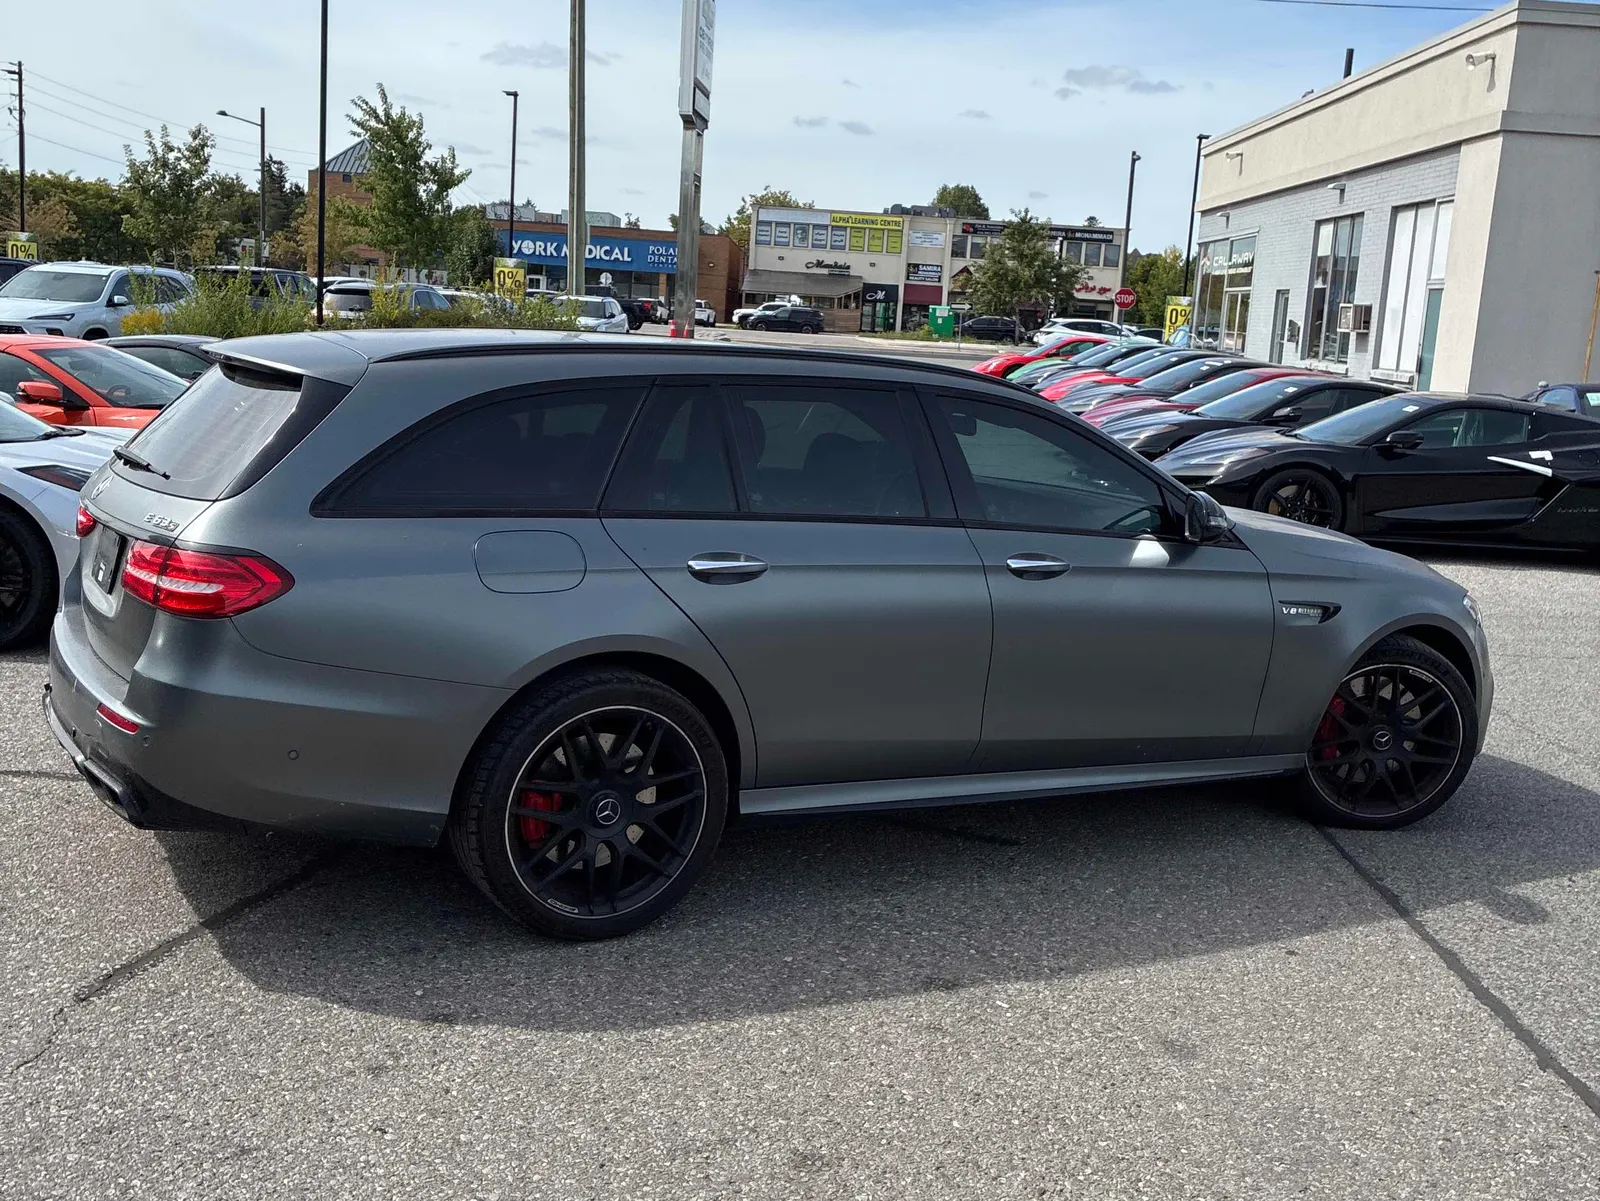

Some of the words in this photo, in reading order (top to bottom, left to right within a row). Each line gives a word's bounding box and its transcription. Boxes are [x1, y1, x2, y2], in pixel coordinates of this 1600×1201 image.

[832, 216, 850, 224] ALPHA
[851, 217, 879, 226] LEARNING
[880, 219, 902, 227] CENTRE
[1075, 232, 1113, 240] MOHAMMADI
[512, 240, 558, 257] YORK
[647, 255, 678, 264] DENTA
[918, 264, 942, 272] SAMIRA
[498, 270, 522, 288] 0%
[1116, 294, 1135, 304] STOP
[1169, 308, 1191, 325] 0%
[1282, 607, 1297, 615] V8
